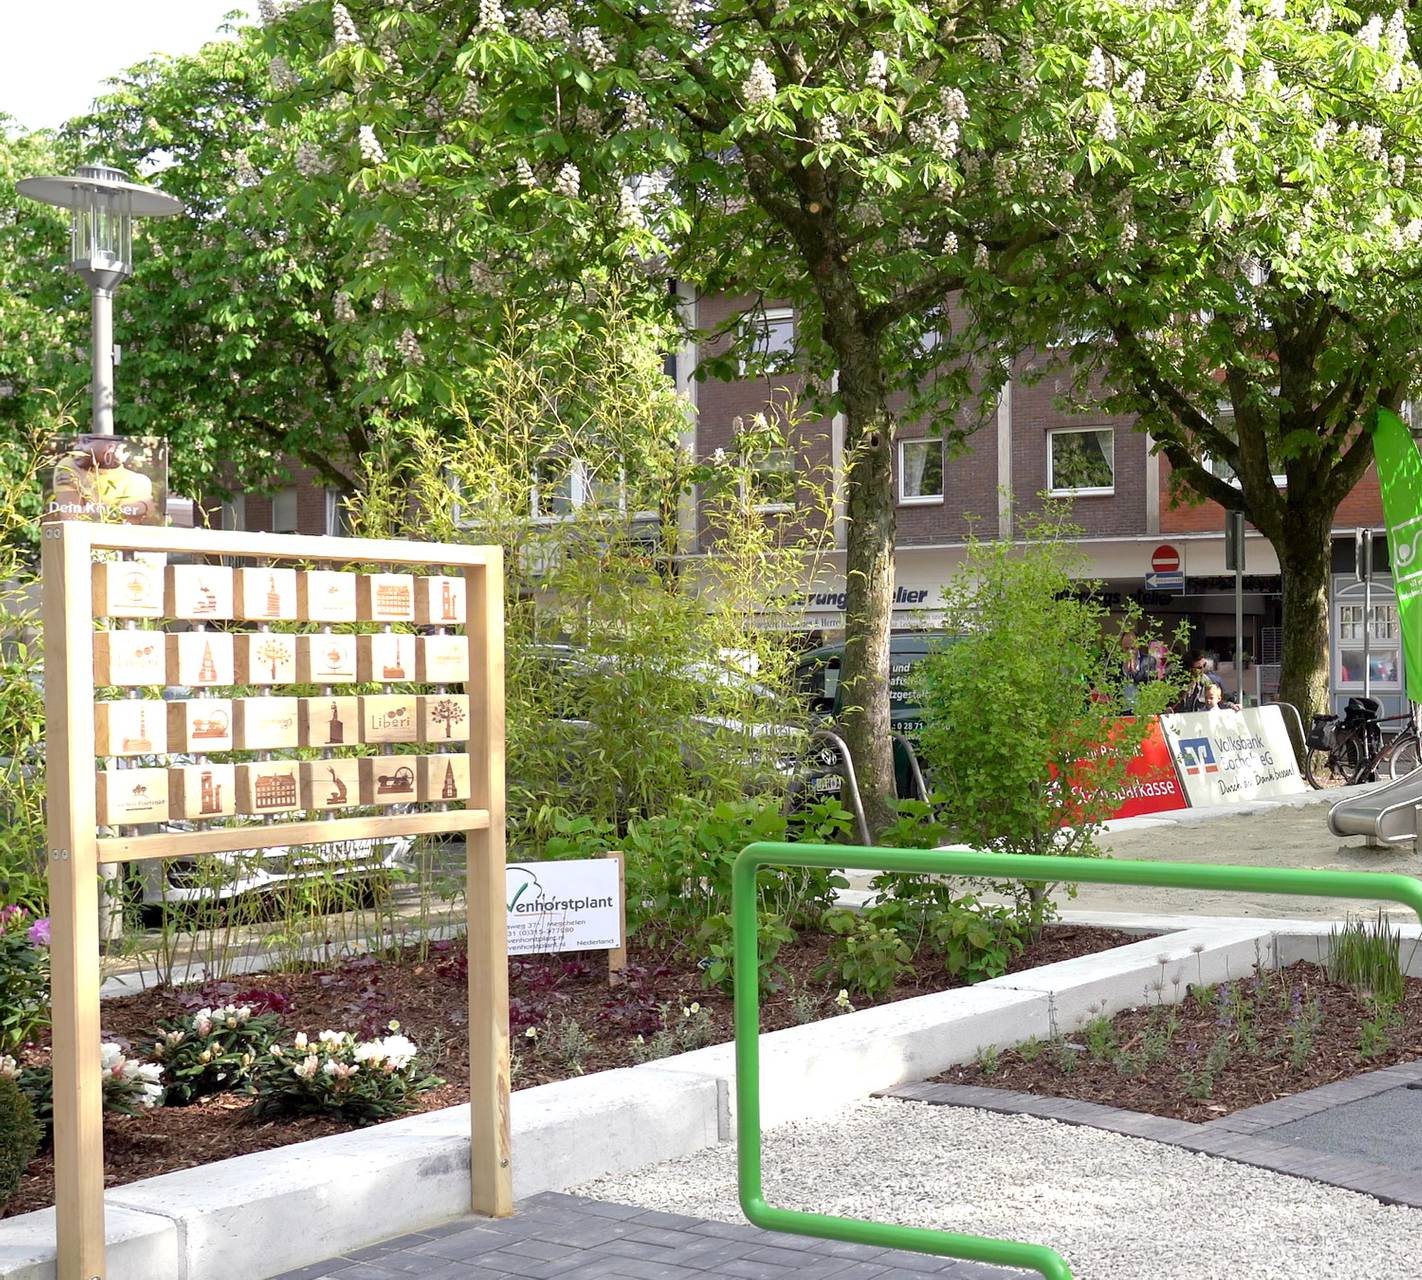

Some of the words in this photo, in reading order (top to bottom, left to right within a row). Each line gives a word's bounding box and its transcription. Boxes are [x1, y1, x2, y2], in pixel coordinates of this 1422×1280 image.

[892, 663, 911, 673] und
[371, 713, 411, 730] Liberi
[1214, 733, 1265, 753] Volksbank
[1260, 750, 1274, 767] eG
[576, 938, 615, 947] Nederland
